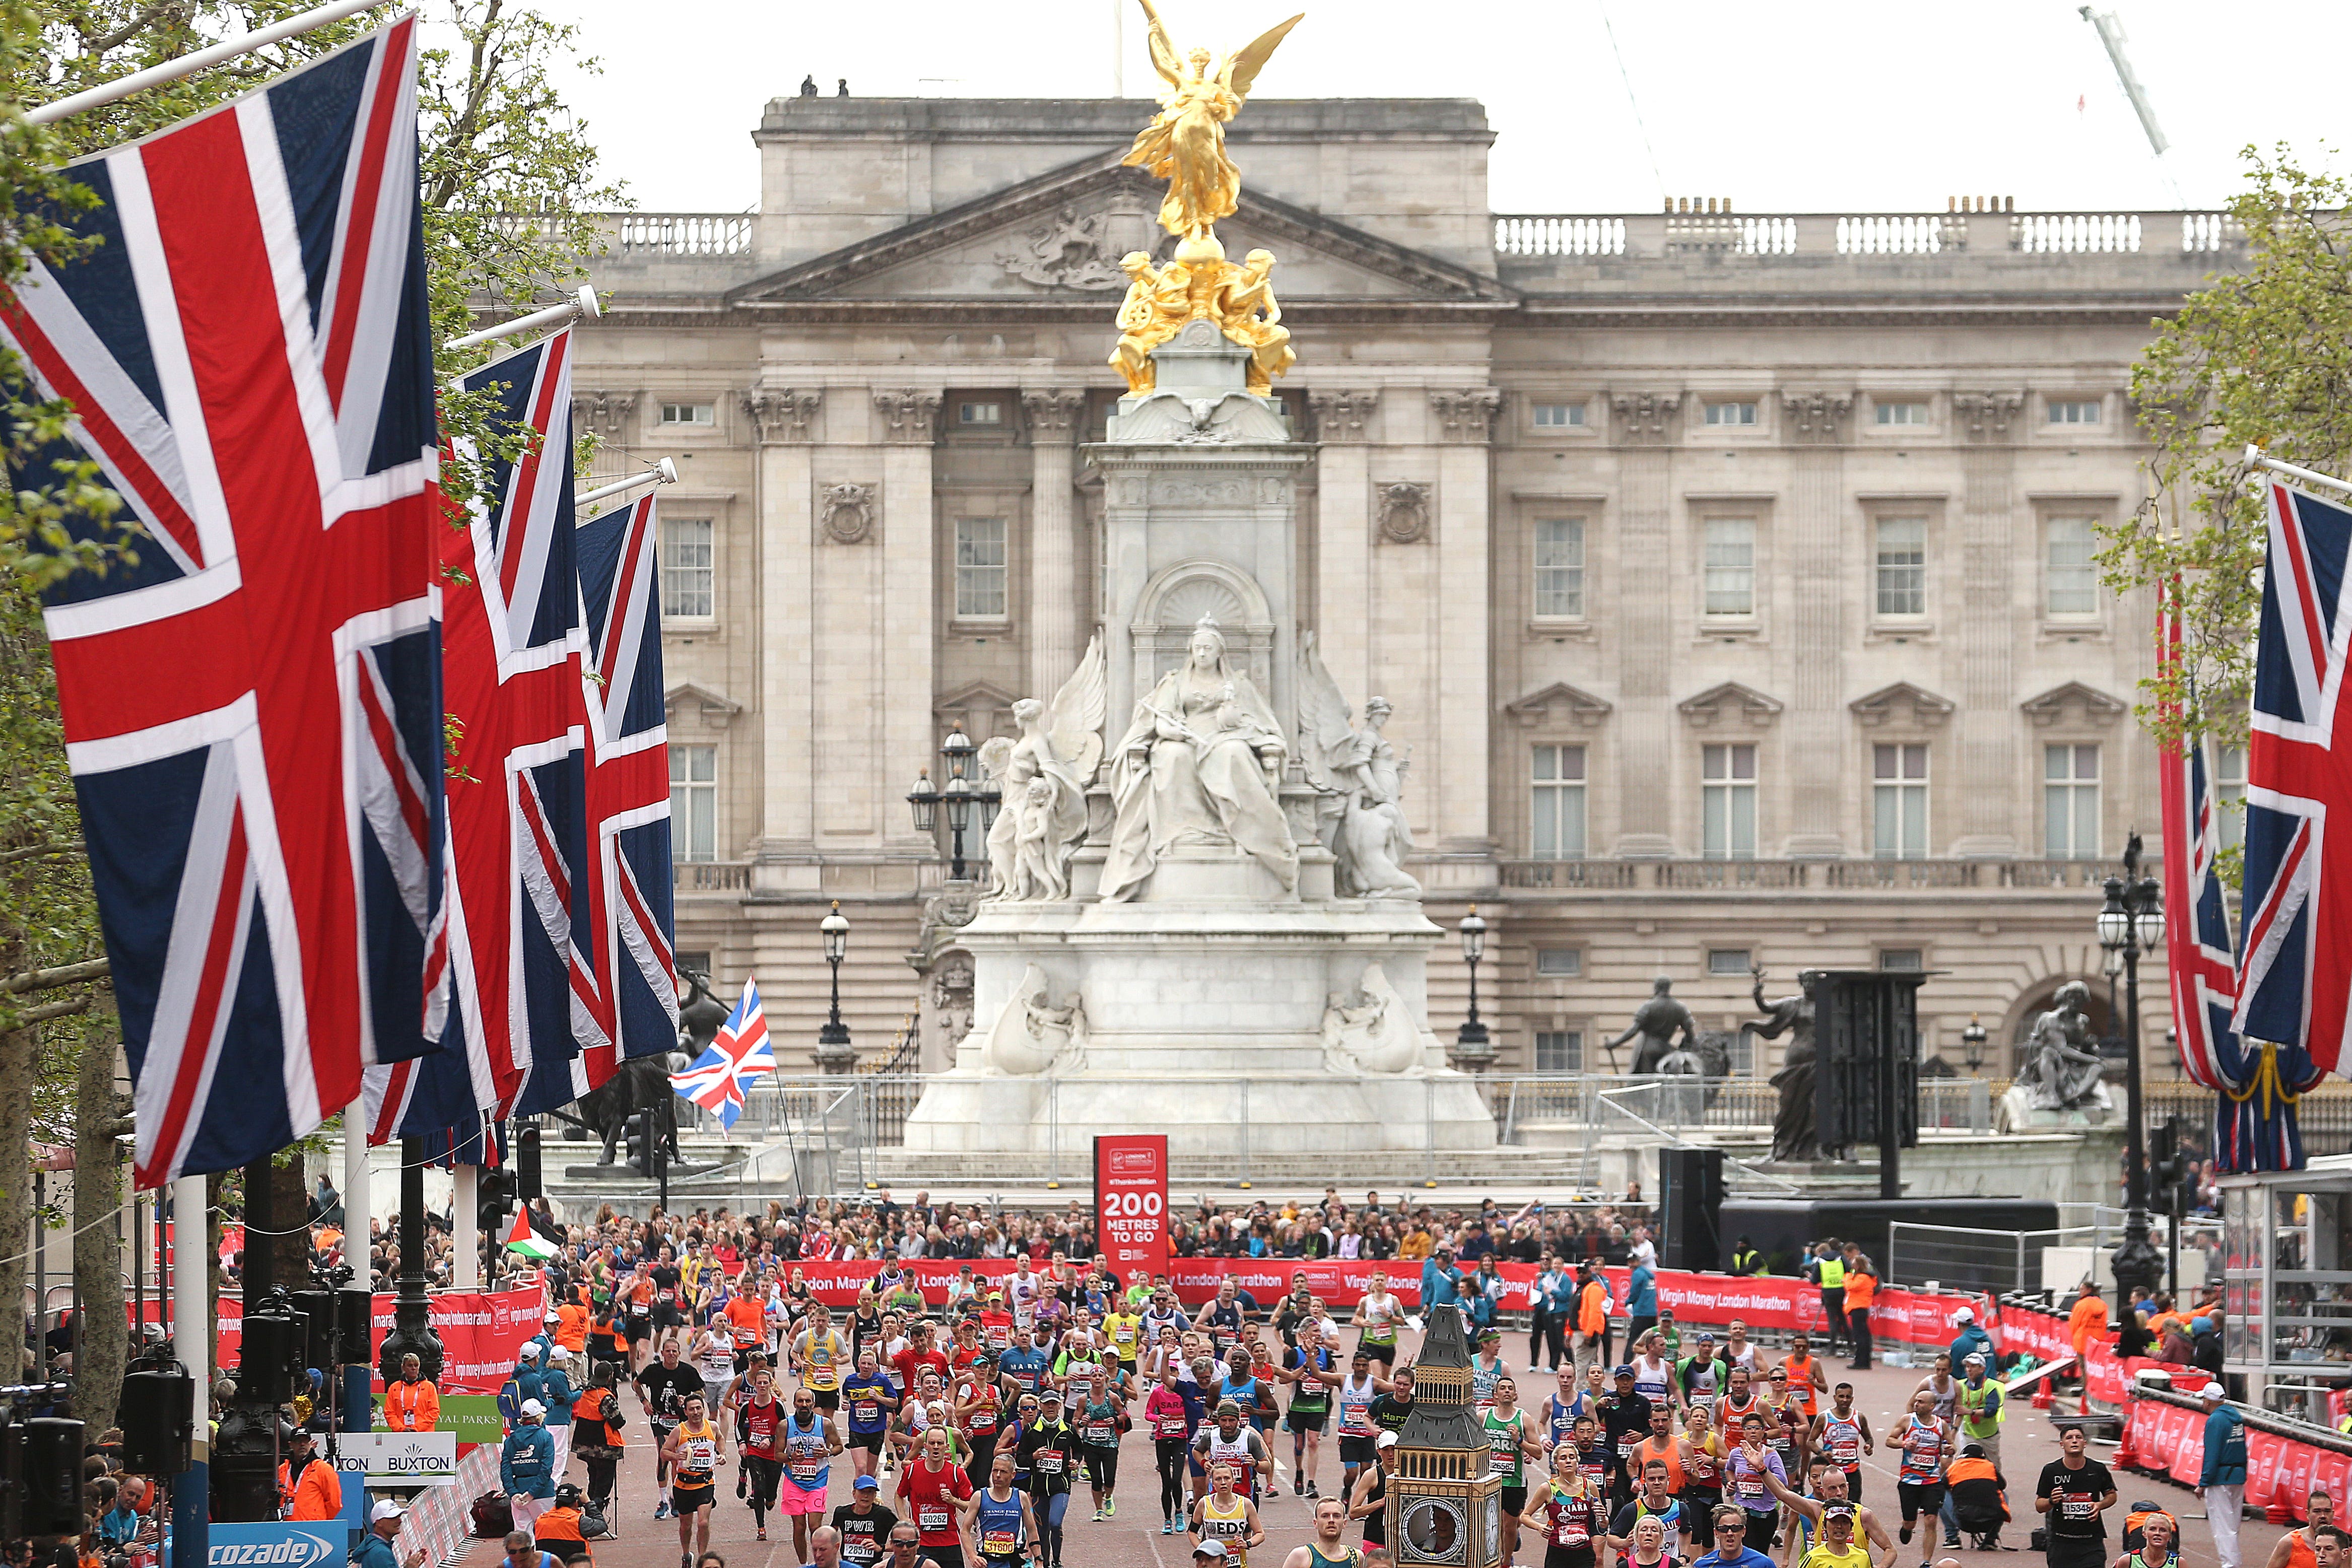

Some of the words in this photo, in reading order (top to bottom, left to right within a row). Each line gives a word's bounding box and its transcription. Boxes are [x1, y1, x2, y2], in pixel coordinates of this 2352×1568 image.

[1104, 1192, 1162, 1216] 200
[1107, 1219, 1159, 1231] METRES
[1112, 1232, 1131, 1243] TO
[1133, 1232, 1155, 1243] GO
[1178, 1273, 1221, 1286] London
[1659, 1287, 1686, 1307] Virgin
[1687, 1291, 1716, 1309] Money
[1717, 1292, 1749, 1309] London
[1751, 1294, 1790, 1312] Marathon
[374, 1311, 396, 1328] marat
[1473, 1370, 1499, 1380] JAMES
[1382, 1412, 1408, 1421] Harr
[1563, 1407, 1574, 1417] AL
[462, 1416, 497, 1425] PARKS
[687, 1435, 708, 1444] STEVE
[388, 1457, 449, 1471] BUXTON
[1040, 1459, 1061, 1468] 69755
[1492, 1462, 1514, 1470] 26562
[794, 1465, 816, 1474] 50418
[2054, 1474, 2071, 1484] DW
[1739, 1483, 1763, 1492] 34795
[1562, 1504, 1588, 1512] CIARA
[2066, 1504, 2091, 1513] 15348
[923, 1515, 946, 1523] 60262
[844, 1520, 875, 1532] PWR
[987, 1542, 1013, 1552] 31600
